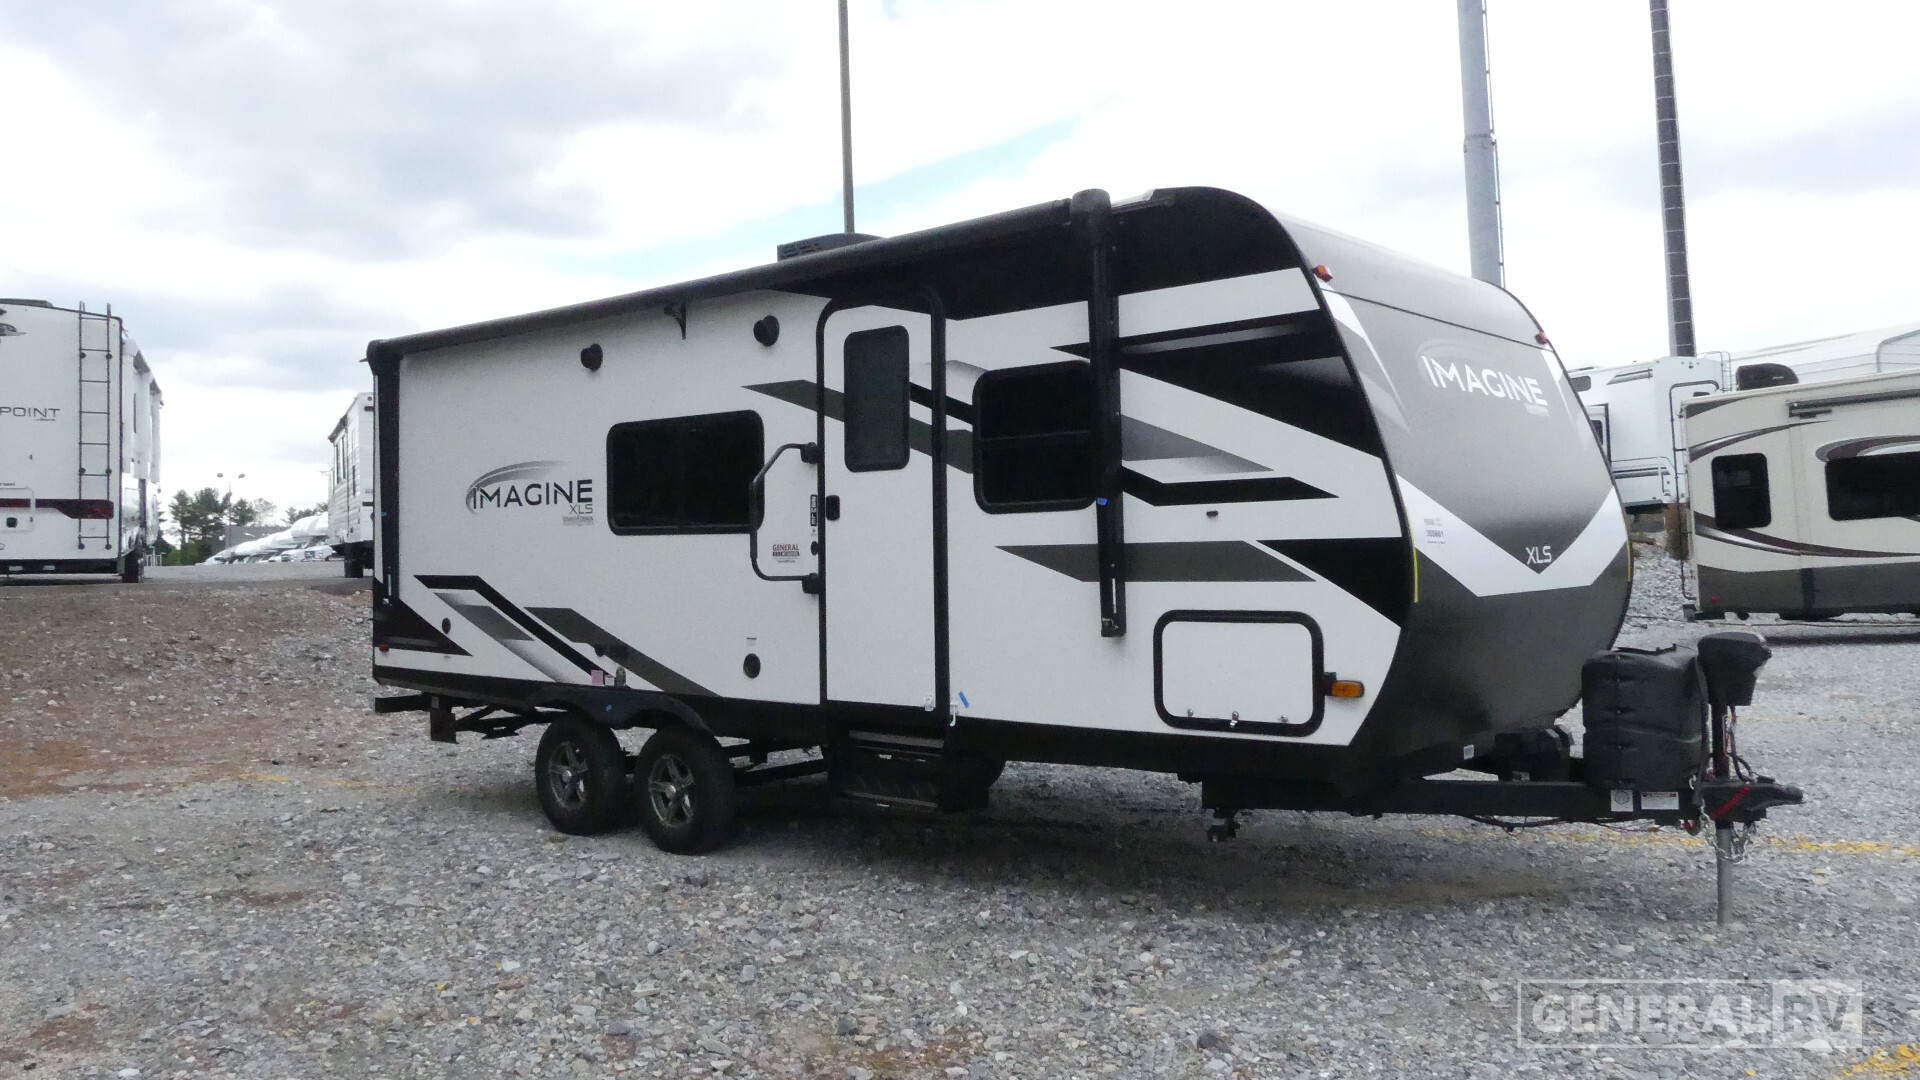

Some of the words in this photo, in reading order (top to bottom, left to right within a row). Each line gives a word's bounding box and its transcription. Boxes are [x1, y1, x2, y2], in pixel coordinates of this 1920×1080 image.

[1420, 355, 1549, 406] IMAGINE
[472, 479, 593, 510] IMAGINE
[569, 503, 594, 515] XLS
[772, 543, 800, 552] GENERAL
[1525, 545, 1552, 566] XLS
